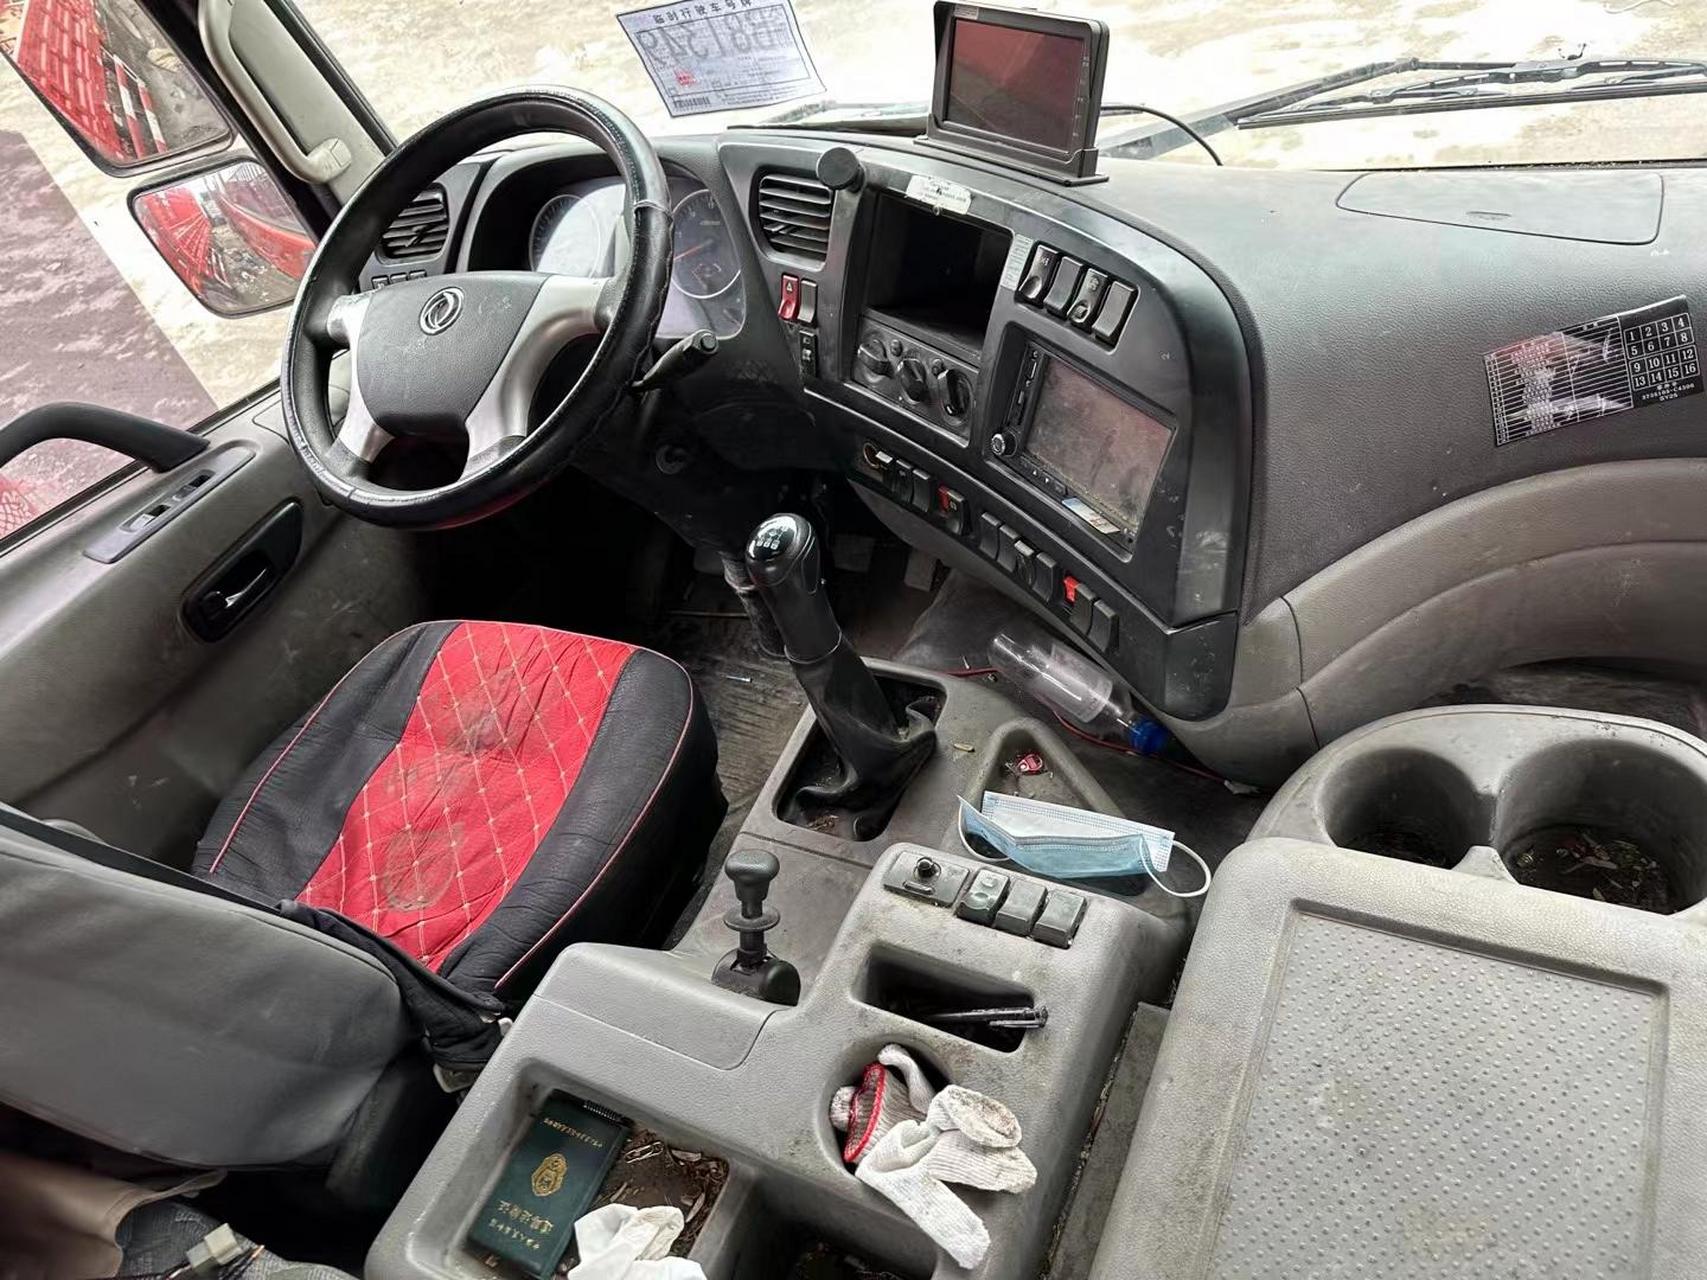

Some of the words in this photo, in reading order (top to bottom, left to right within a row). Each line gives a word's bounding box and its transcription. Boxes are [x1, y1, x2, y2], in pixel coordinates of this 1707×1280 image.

[1630, 331, 1635, 341] 1
[1644, 326, 1653, 337] 2
[1661, 322, 1669, 332] 3
[1678, 317, 1685, 328] 4
[1631, 345, 1638, 356] 5
[1647, 341, 1655, 351] 6
[1663, 336, 1671, 347] 7
[1680, 332, 1688, 342] 8
[1633, 362, 1641, 373] 9
[1648, 357, 1660, 369] 10
[1665, 353, 1677, 365] 11
[1682, 349, 1694, 360] 12
[1634, 376, 1646, 387] 13
[1651, 371, 1662, 383] 14
[1667, 367, 1679, 379] 15
[1684, 363, 1696, 375] 16
